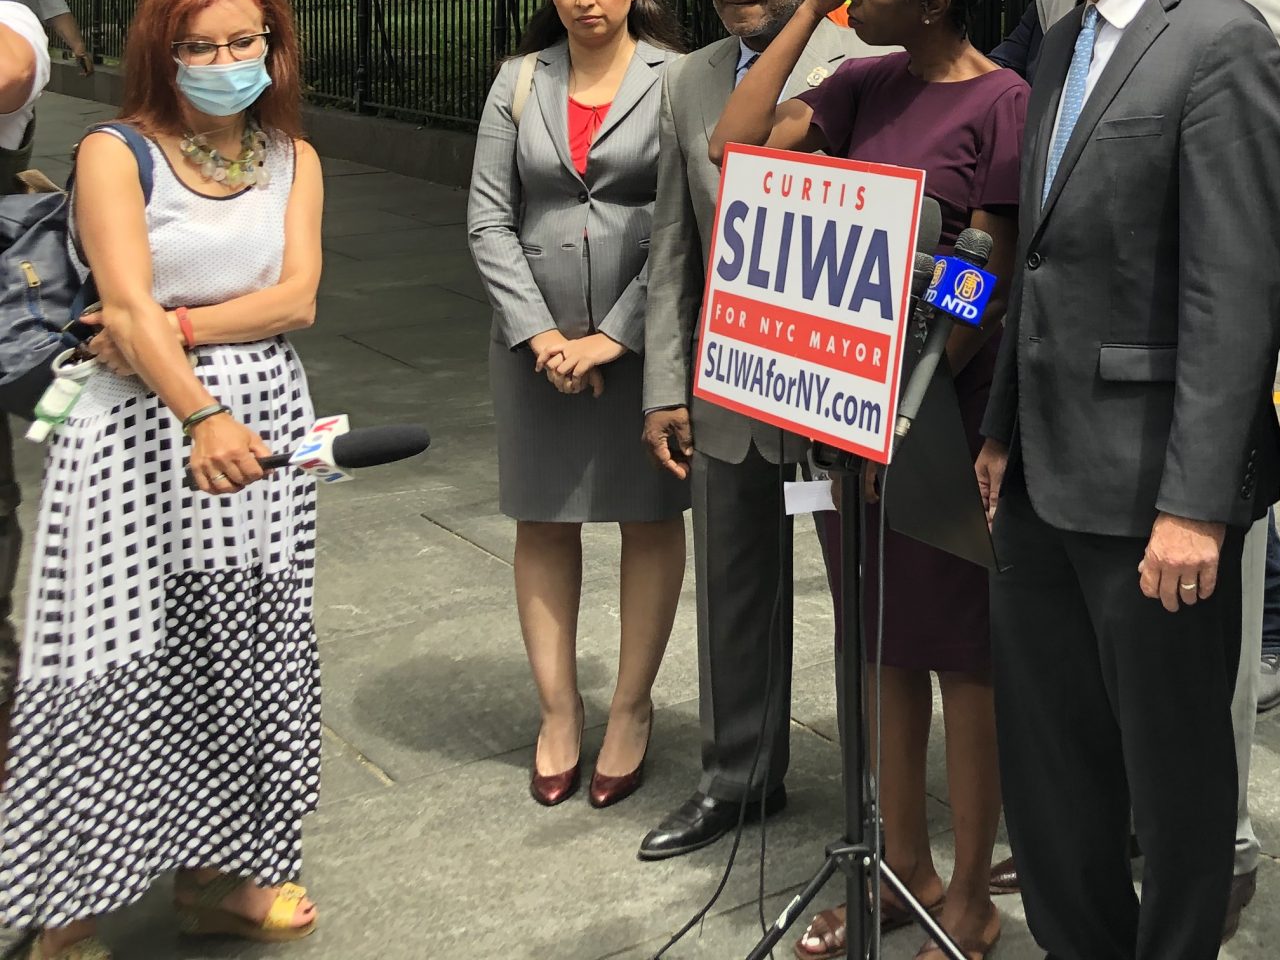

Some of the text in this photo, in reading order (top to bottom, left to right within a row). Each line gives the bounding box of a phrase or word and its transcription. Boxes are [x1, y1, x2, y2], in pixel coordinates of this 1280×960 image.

[762, 170, 867, 211] CURTIS
[716, 200, 894, 321] SLIWA
[715, 303, 882, 367] FOR NYC MAYOR
[941, 294, 978, 319] NTD
[704, 341, 882, 434] SLIWAforNY.com
